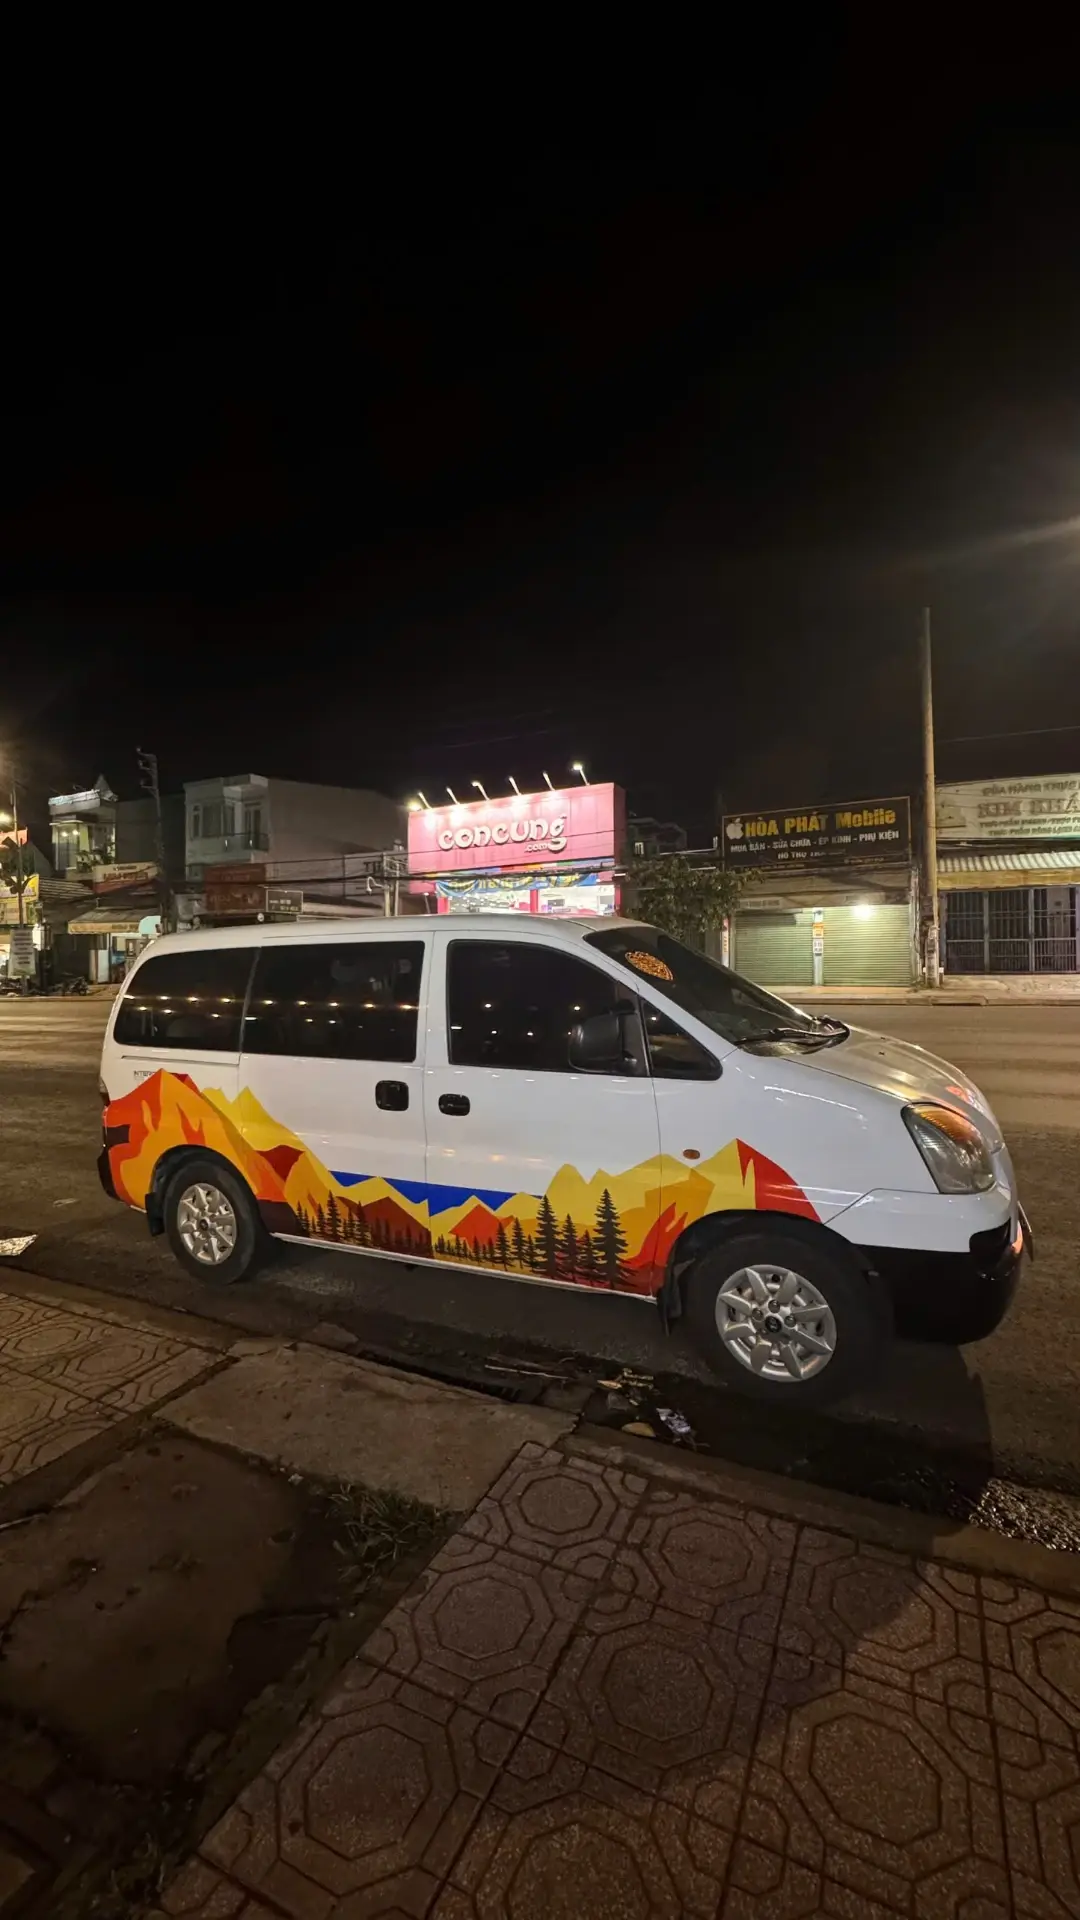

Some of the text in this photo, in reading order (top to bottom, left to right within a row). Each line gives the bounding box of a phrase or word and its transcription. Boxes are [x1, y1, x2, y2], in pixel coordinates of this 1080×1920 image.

[745, 808, 896, 837] HÒA PHÁT Mobile
[859, 832, 876, 842] PHỤ
[879, 829, 899, 841] KIỆN
